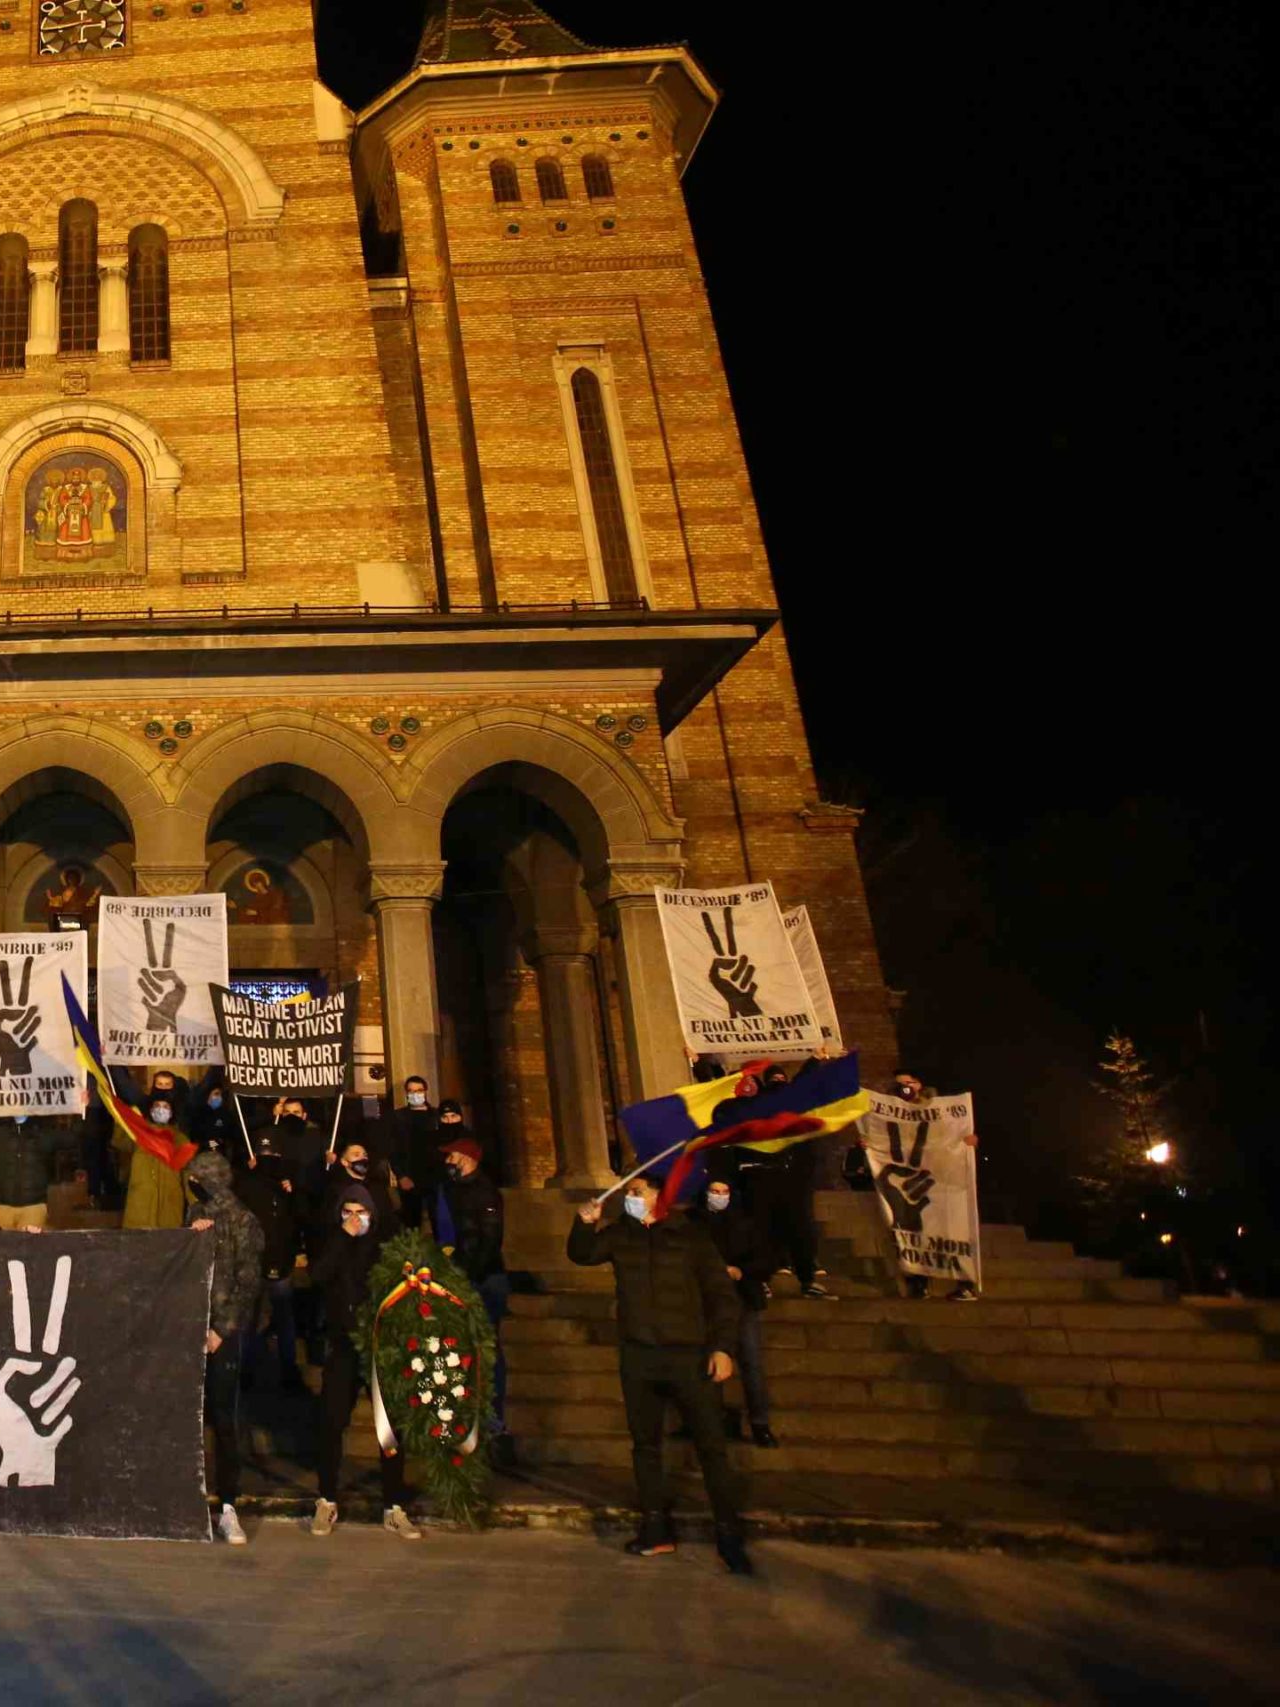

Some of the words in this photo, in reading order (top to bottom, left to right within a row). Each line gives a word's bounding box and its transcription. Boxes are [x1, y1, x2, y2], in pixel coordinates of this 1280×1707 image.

[664, 893, 741, 907] DECEMBRIE
[222, 992, 251, 1016] MAI
[254, 1000, 291, 1020] BINE
[295, 991, 345, 1019] GOLAN
[275, 1012, 344, 1040] ACTIVIST
[741, 1018, 764, 1031] NU
[769, 1014, 810, 1030] MOR
[228, 1042, 255, 1065] MAI
[257, 1046, 294, 1068] BINE
[297, 1043, 342, 1066] MORT
[9, 1077, 32, 1091] NU
[38, 1075, 75, 1090] MOR
[229, 1063, 273, 1087] DECAT
[277, 1064, 345, 1088] COMUNIS
[927, 1236, 972, 1257] MOR
